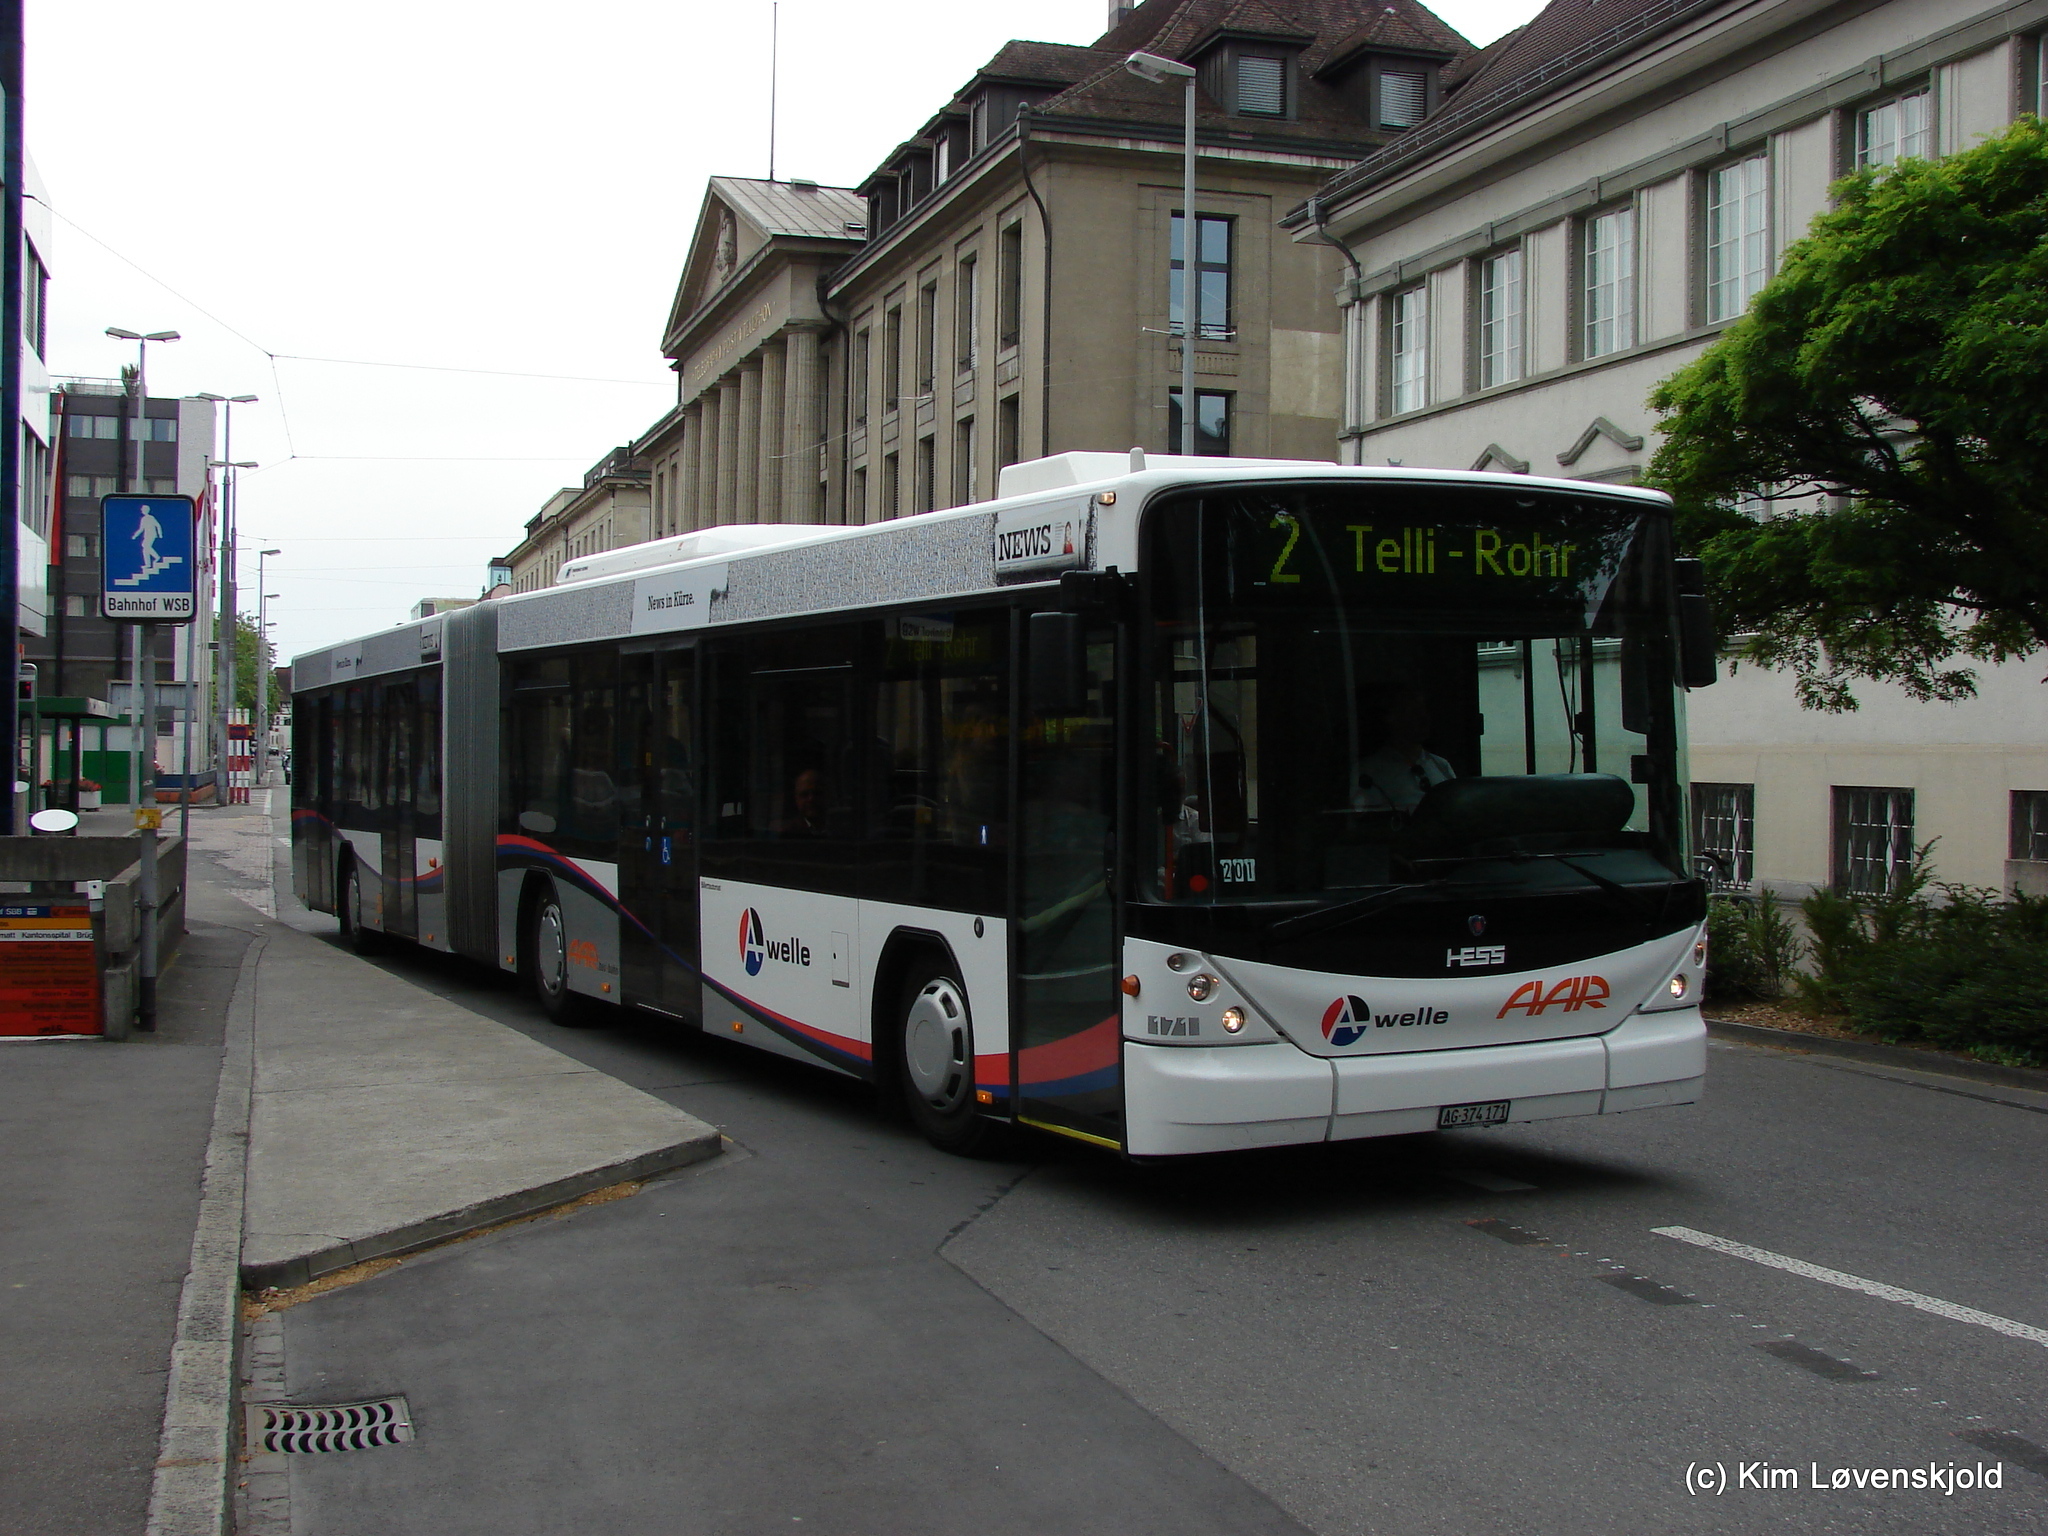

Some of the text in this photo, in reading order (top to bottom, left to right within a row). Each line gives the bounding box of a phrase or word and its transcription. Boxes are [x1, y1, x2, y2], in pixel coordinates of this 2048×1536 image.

[998, 523, 1051, 562] NEWS
[1269, 513, 1300, 583] 2
[1346, 525, 1435, 574] Telli
[1475, 529, 1577, 578] Rohr
[108, 597, 190, 611] Bahnhof WSB
[647, 595, 665, 611] News
[665, 593, 673, 609] in
[1221, 860, 1255, 881] 201
[766, 936, 811, 967] welle
[1446, 945, 1506, 968] HESS
[1374, 1006, 1449, 1029] welle
